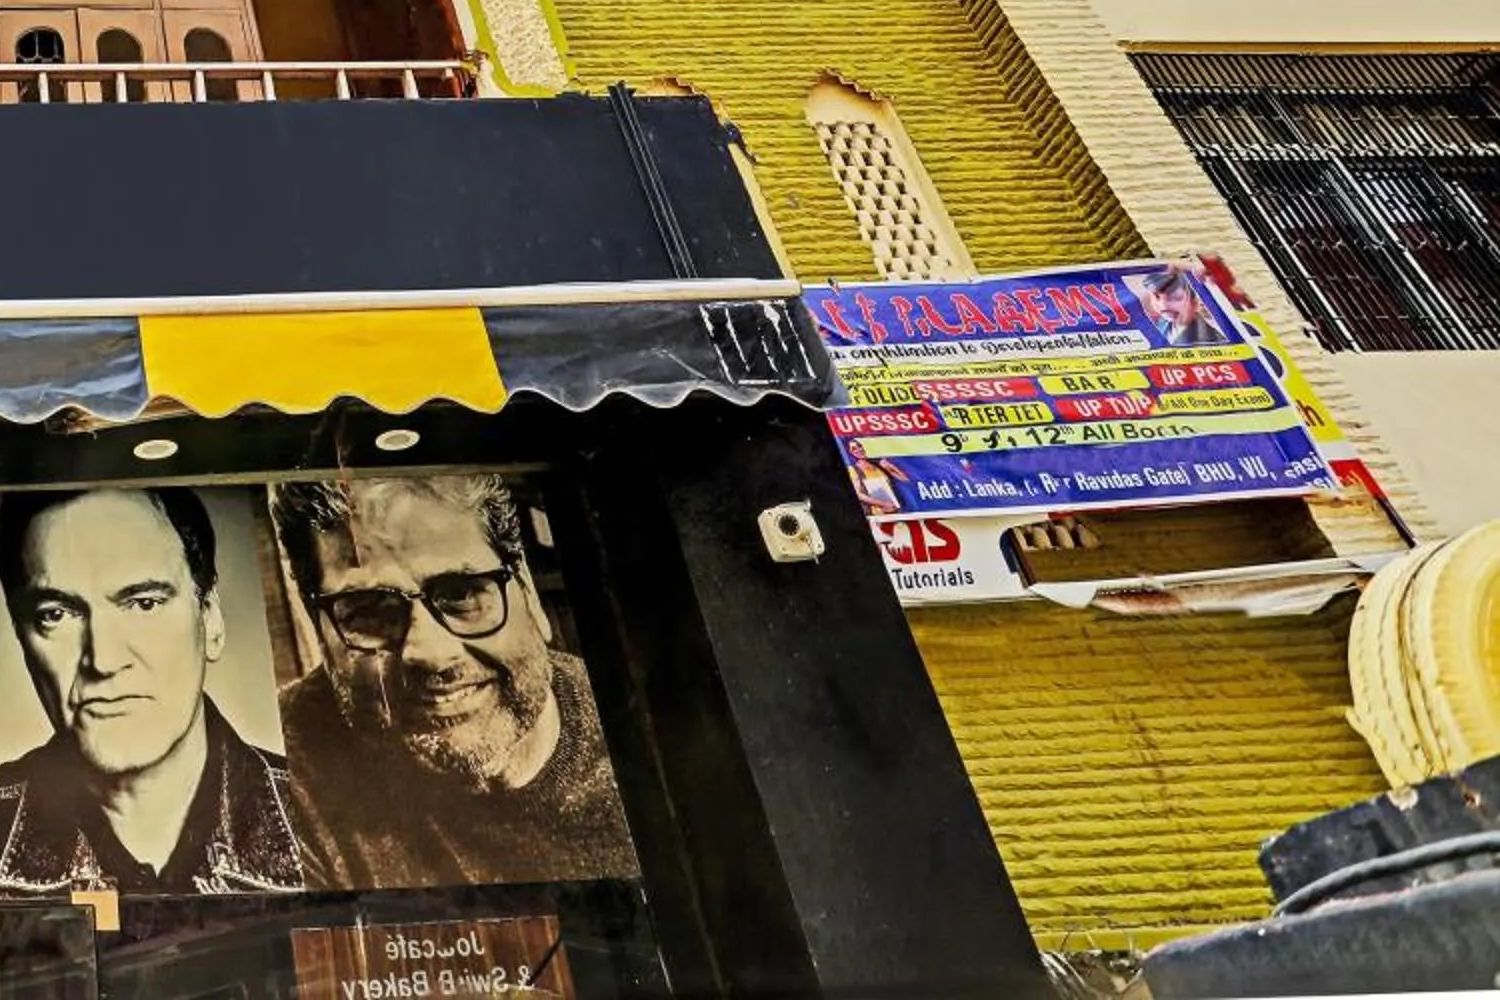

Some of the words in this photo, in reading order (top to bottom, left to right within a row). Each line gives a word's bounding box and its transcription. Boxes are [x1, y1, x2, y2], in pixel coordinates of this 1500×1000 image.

[1160, 367, 1187, 385] UP
[1191, 364, 1237, 382] PCS
[835, 411, 930, 434] UPSSSC
[1083, 423, 1115, 441] All
[916, 480, 955, 501] Add
[1075, 467, 1144, 491] Ravidas
